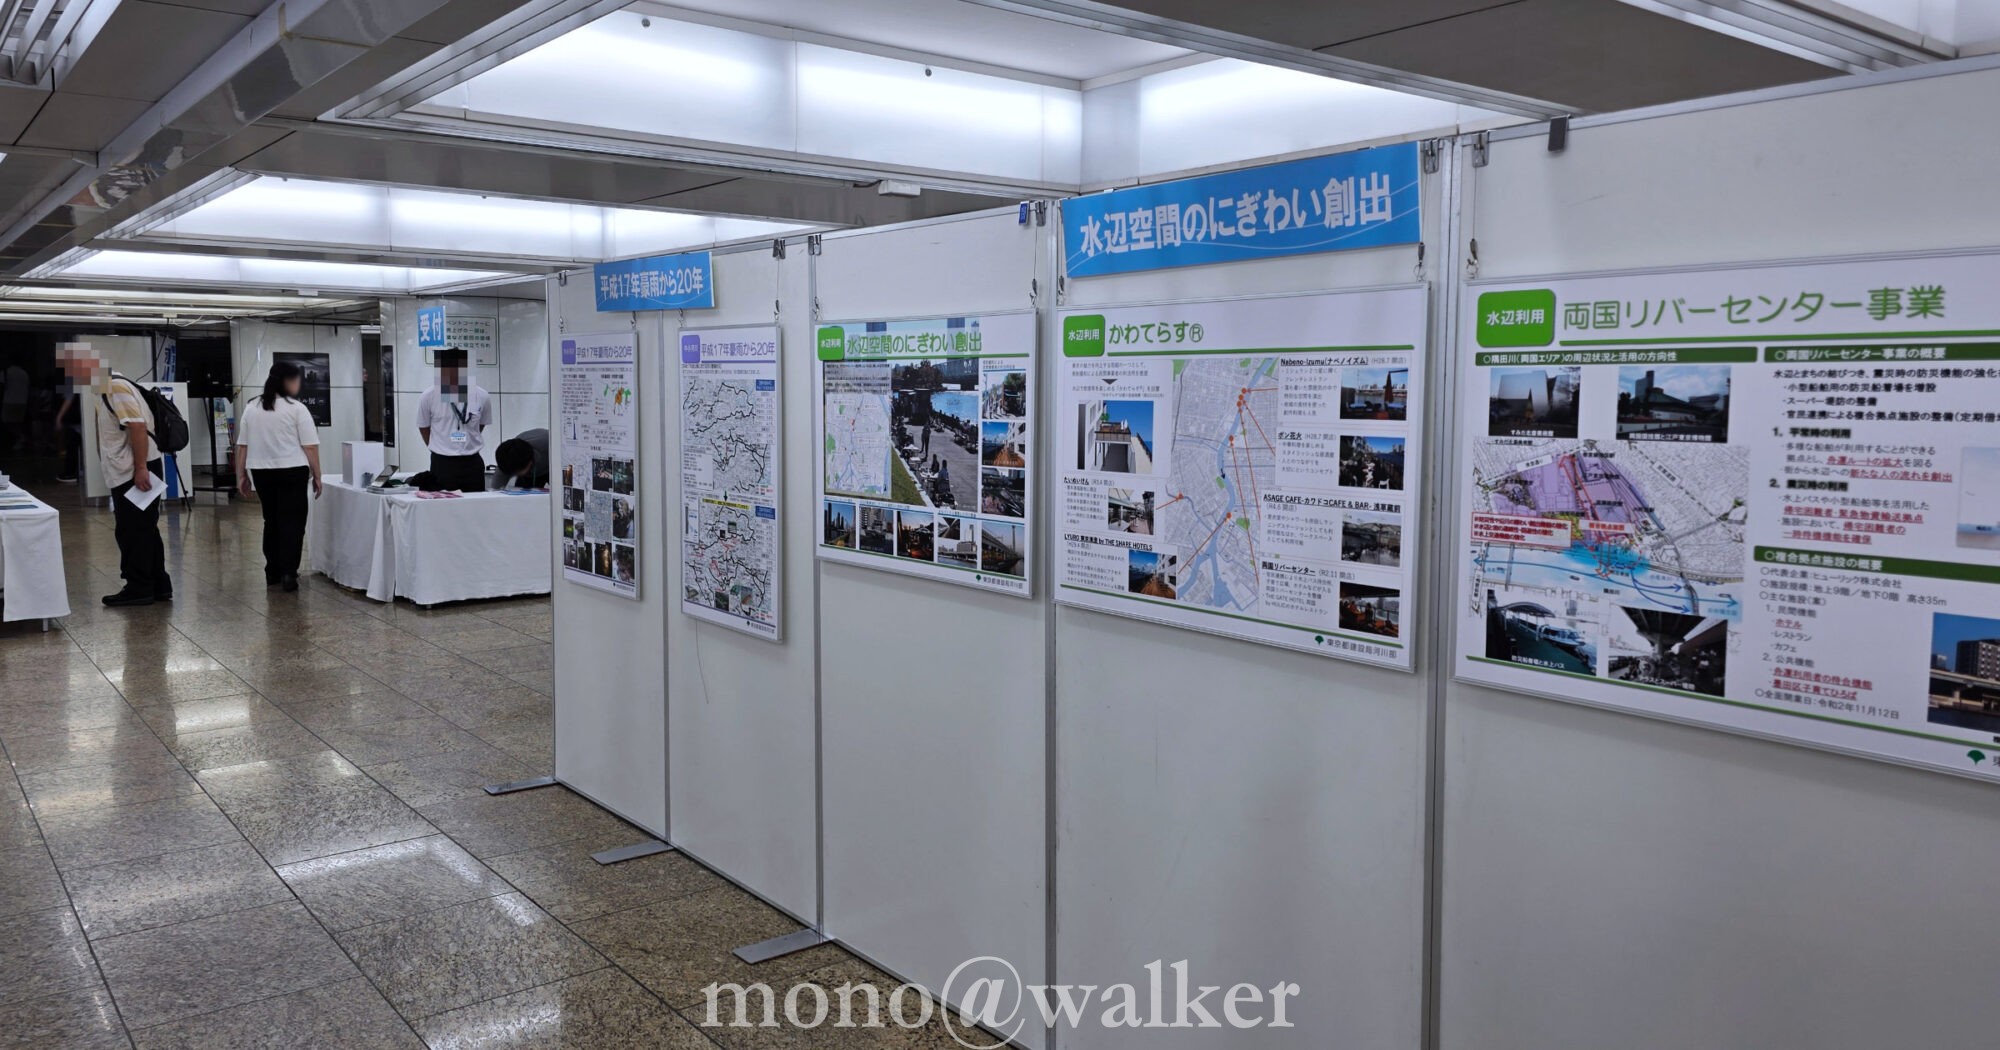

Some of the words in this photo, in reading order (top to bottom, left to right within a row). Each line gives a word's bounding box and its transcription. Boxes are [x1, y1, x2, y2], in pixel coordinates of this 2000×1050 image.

[1080, 171, 1392, 258] 水辺空間のにぎわい創出
[600, 266, 704, 300] 平成17年豪雨から20年
[1563, 284, 1946, 331] 両国リバーセンター事業
[1486, 308, 1545, 326] 水辺利用
[420, 311, 442, 342] 受付
[1068, 328, 1100, 341] 水辺利用
[701, 341, 775, 357] 平成17年豪雨から20年
[846, 331, 982, 354] 水辺空間のにぎわい創出
[576, 345, 632, 359] 平成17年豪雨から20年
[1789, 427, 1851, 439] 平常時の利用
[1786, 479, 1848, 492] 震災時の利用
[1105, 538, 1115, 546] THE
[1133, 542, 1153, 551] HOTELS
[1262, 561, 1316, 575] 両国リバーセンター
[1778, 605, 1817, 619] 民間機能
[1327, 638, 1398, 658] 東京都建設局河川部
[1776, 654, 1815, 668] 公共機能
